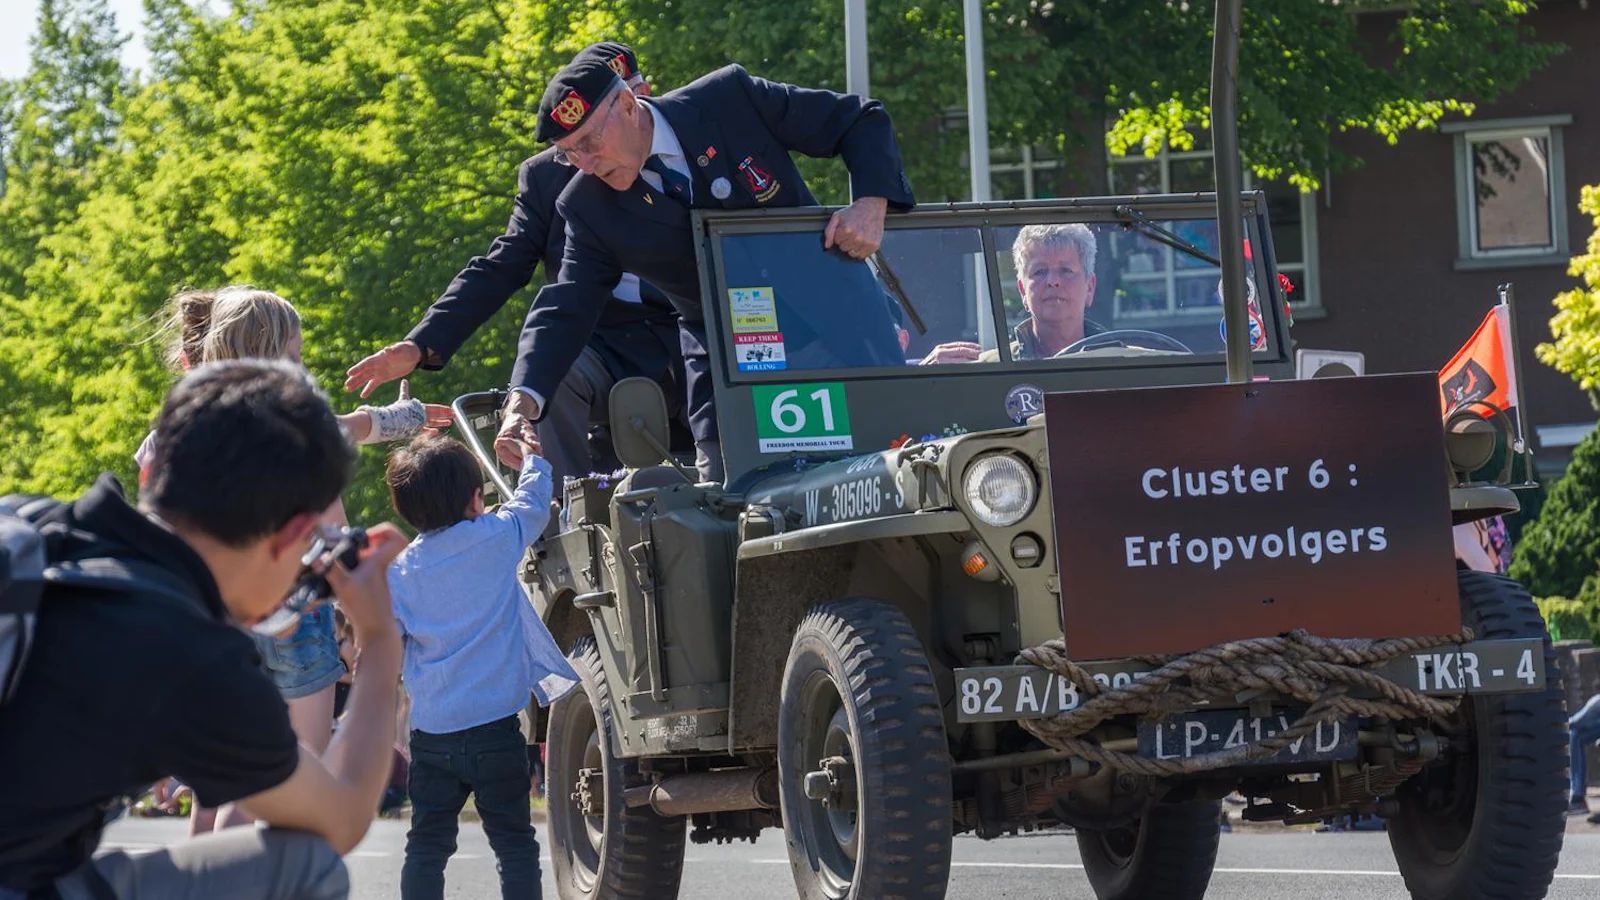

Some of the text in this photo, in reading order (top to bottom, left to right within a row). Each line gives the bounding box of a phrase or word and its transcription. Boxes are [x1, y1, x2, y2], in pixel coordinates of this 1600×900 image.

[738, 334, 778, 343] KEEP THEM
[747, 363, 776, 371] ROLLING
[771, 388, 835, 433] 61
[1141, 464, 1289, 499] Cluster
[1308, 458, 1331, 490] 6
[1124, 525, 1388, 570] Erfopvolgers
[1414, 651, 1482, 690] TKR
[1516, 649, 1536, 685] 4
[961, 677, 1003, 715] 82
